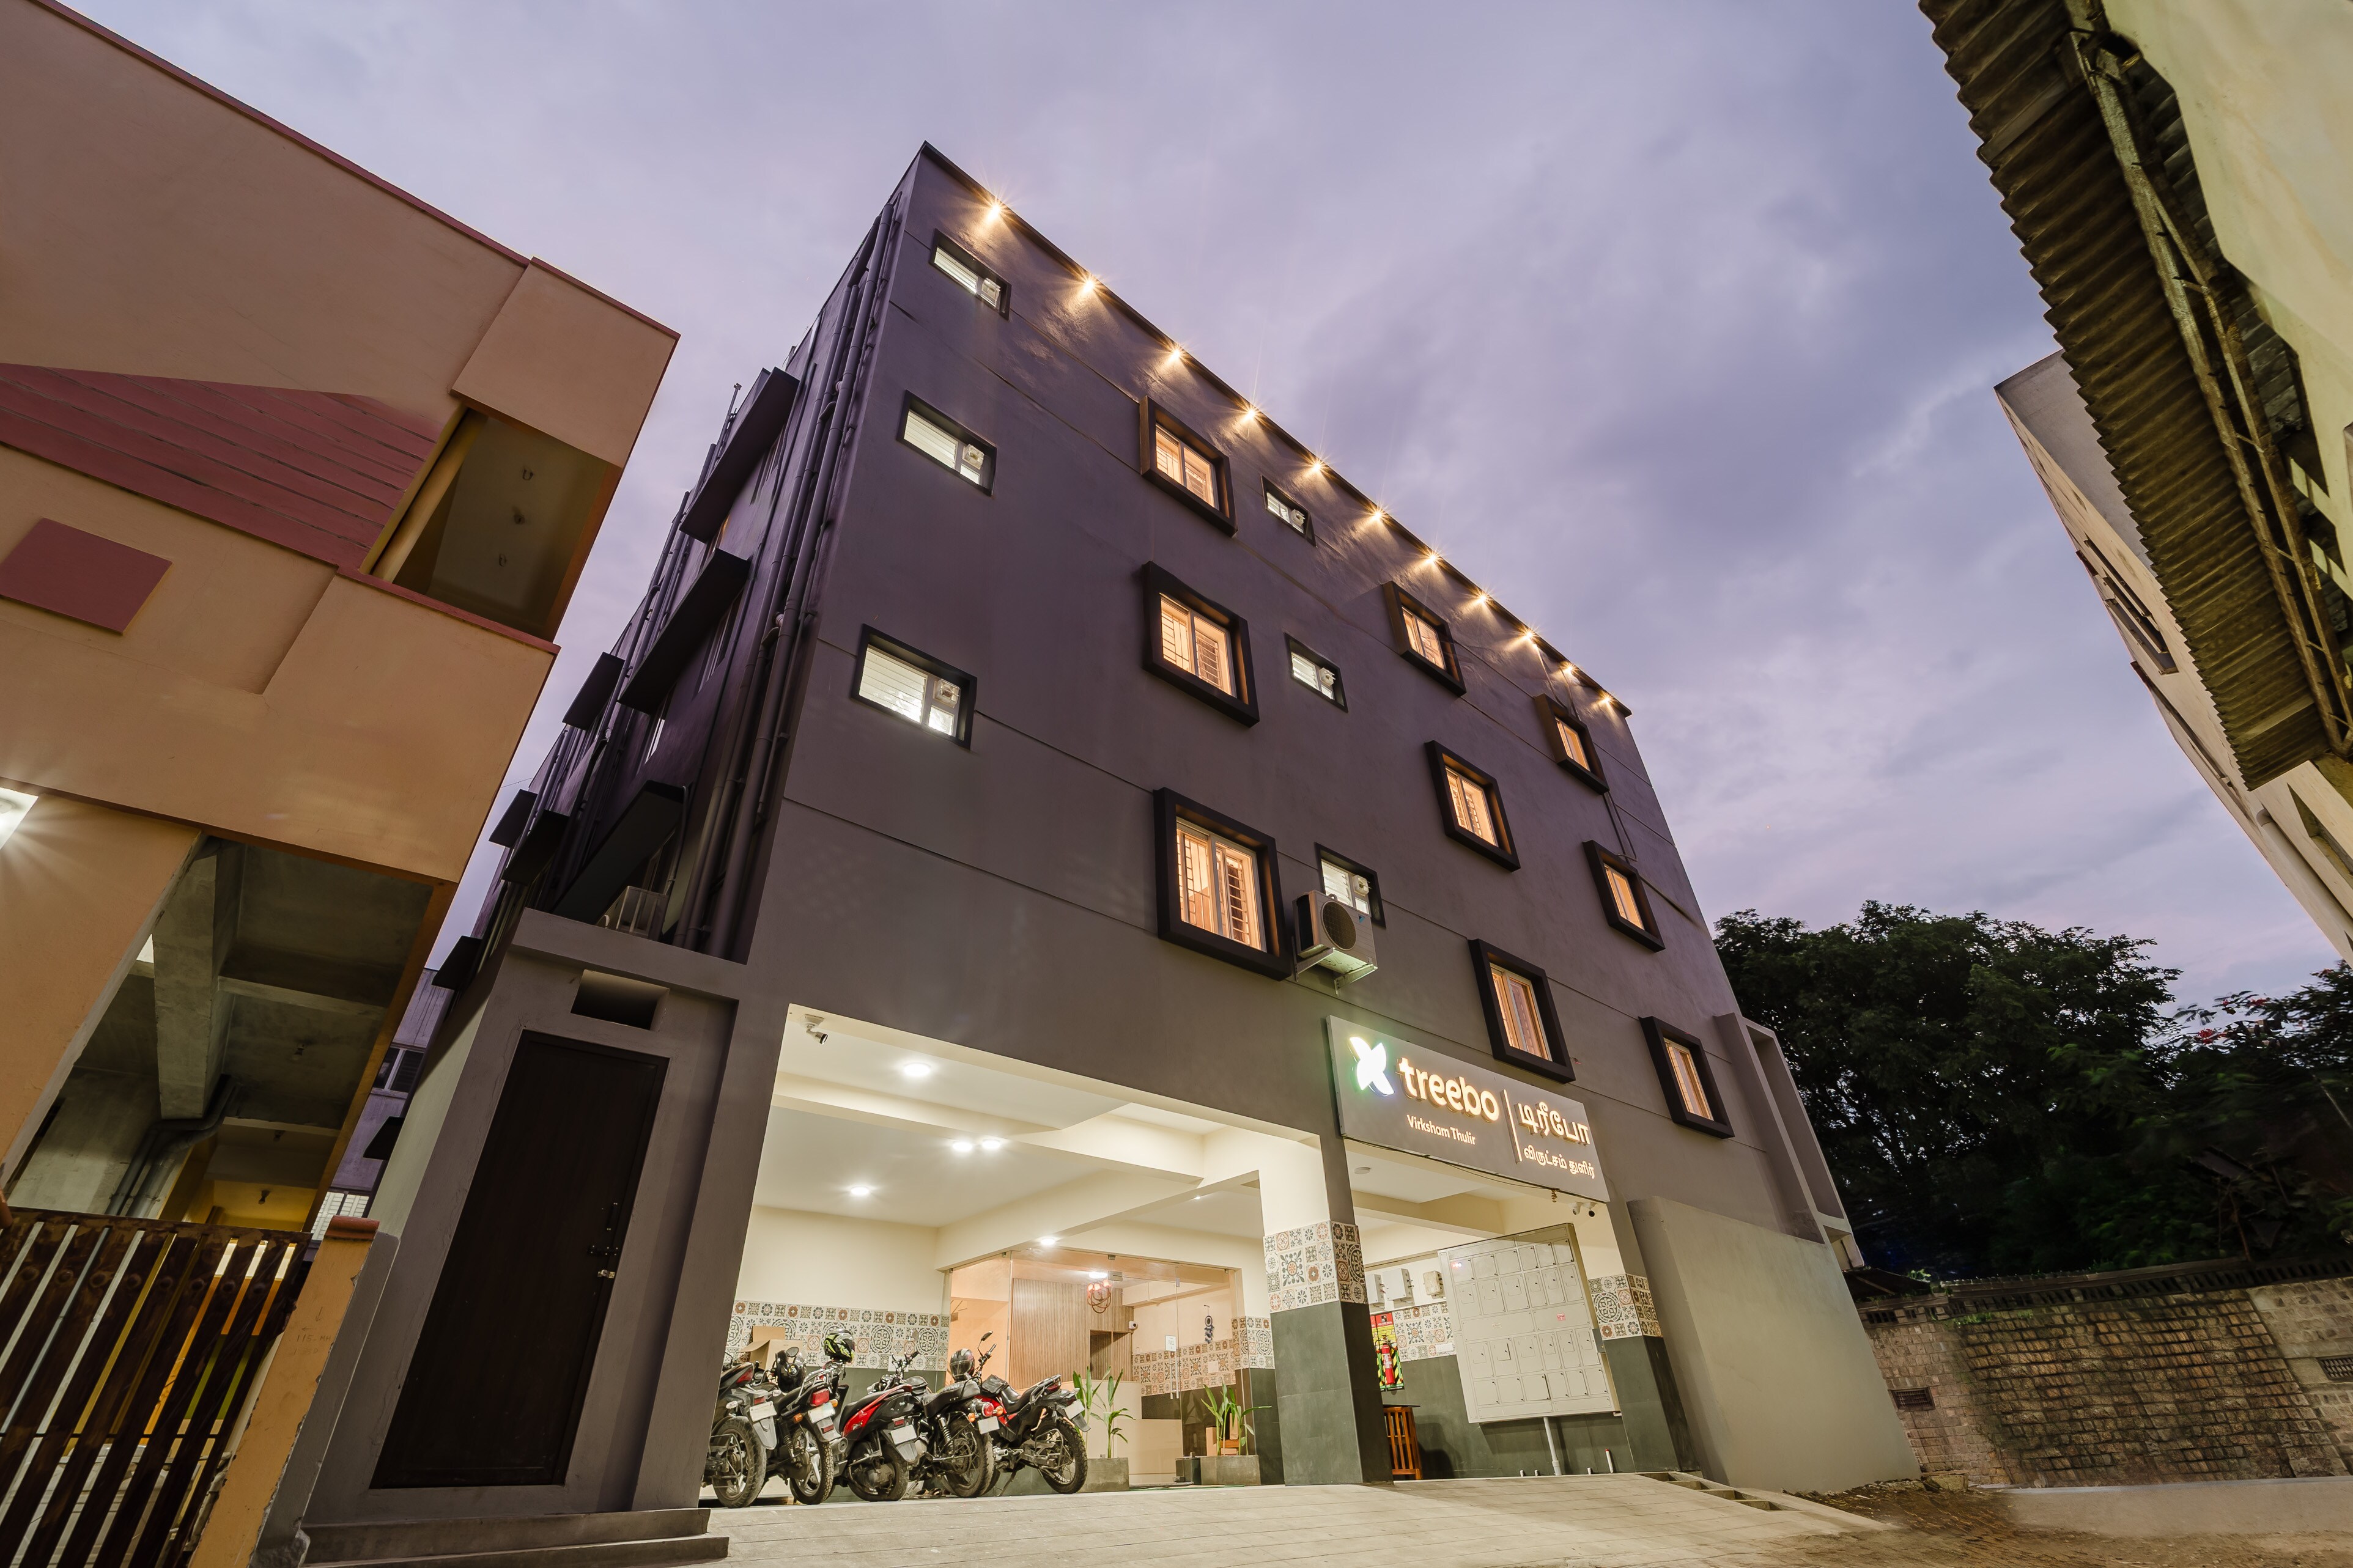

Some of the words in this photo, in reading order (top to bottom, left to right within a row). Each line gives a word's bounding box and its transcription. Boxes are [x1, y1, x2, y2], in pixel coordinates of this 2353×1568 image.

[1397, 1058, 1500, 1121] treebo
[1407, 1114, 1450, 1138] Virksham
[1450, 1127, 1476, 1145] Thulir
[1515, 1102, 1590, 1145] டிரீபோ
[1524, 1144, 1567, 1169] விருட்சம்
[1569, 1161, 1595, 1179] துளிர்
